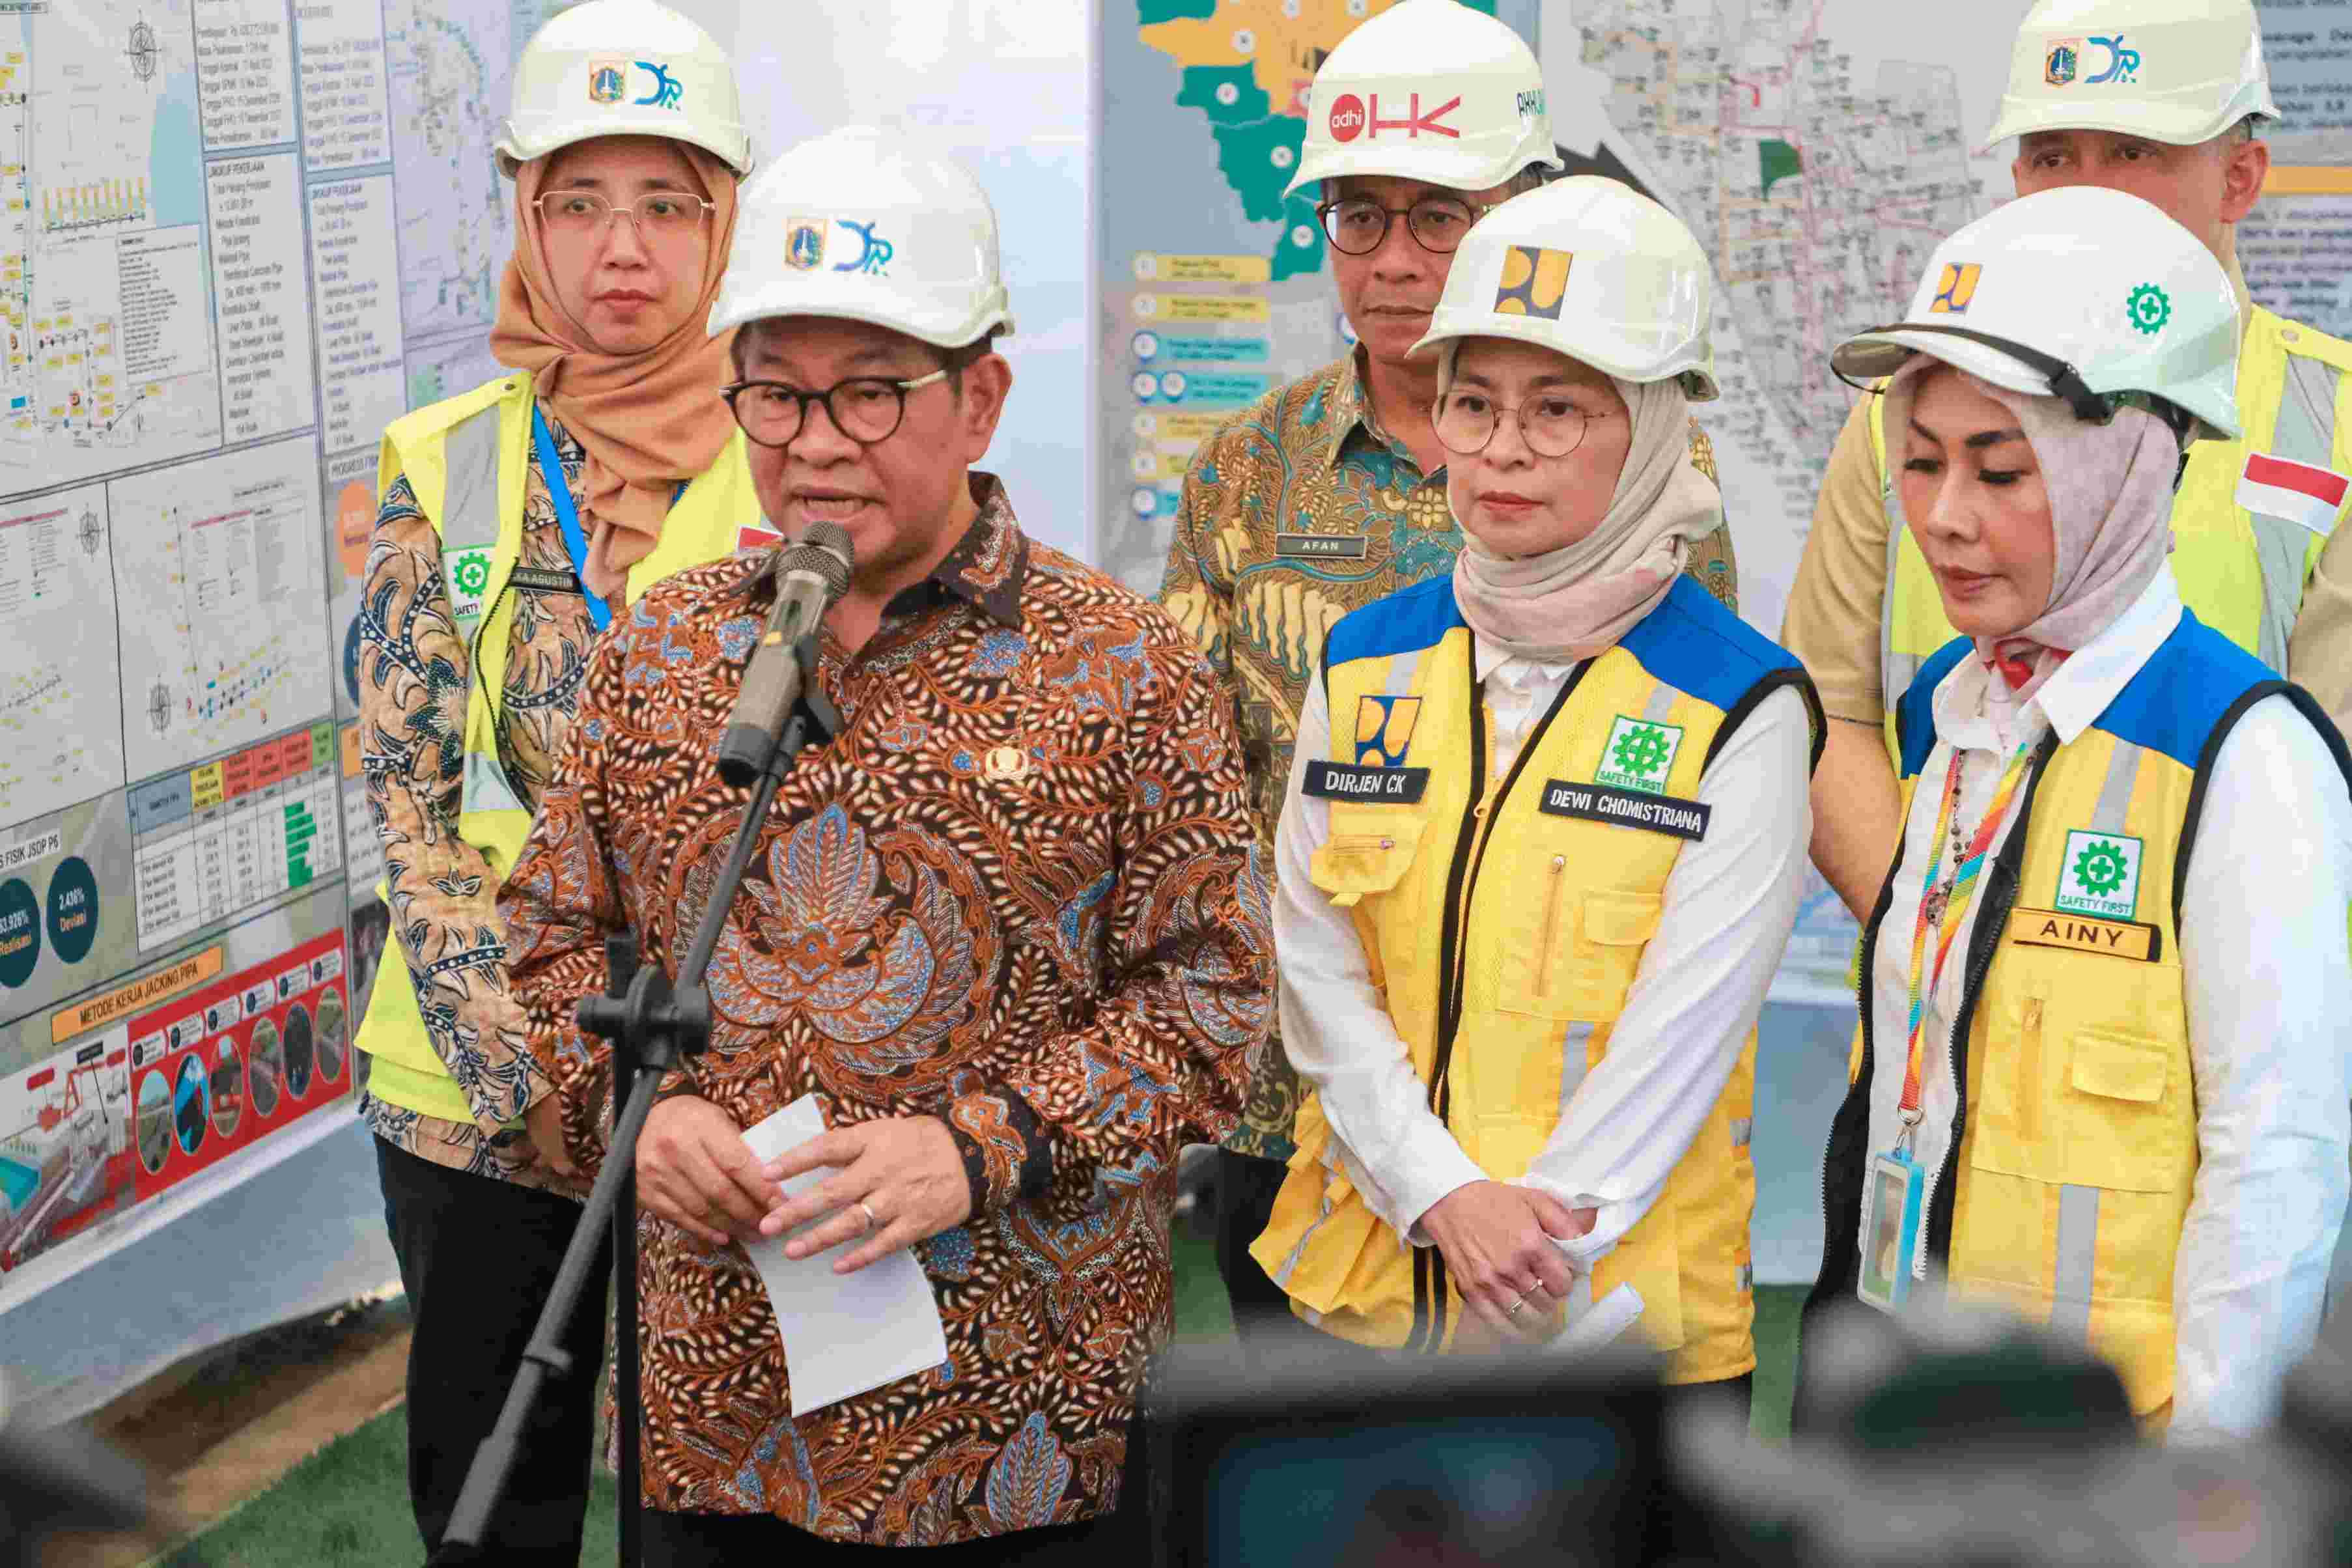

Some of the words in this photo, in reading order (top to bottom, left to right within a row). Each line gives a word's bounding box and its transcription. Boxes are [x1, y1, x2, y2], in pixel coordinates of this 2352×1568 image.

[1332, 109, 1362, 128] adhi
[1302, 541, 1339, 551] AFAN
[531, 573, 573, 587] AGUSTIN
[454, 604, 479, 615] SAFETY
[1324, 770, 1384, 794] DIRJEN
[1386, 774, 1407, 794] CK
[1599, 770, 1634, 785] SAFETY
[1635, 778, 1662, 792] FIRST
[1550, 789, 1592, 811] DEWI
[1596, 794, 1702, 833] CHOMISTRIANA
[5, 847, 27, 865] FISIK
[27, 837, 47, 859] JSDP
[48, 833, 59, 850] P6
[2060, 895, 2100, 909] SAFETY
[2102, 901, 2133, 914] FIRST
[2039, 919, 2123, 947] AINY
[79, 996, 115, 1025] METODE
[115, 984, 143, 1007] KERJA
[144, 969, 180, 998] JACKING
[180, 962, 199, 982] PIPA
